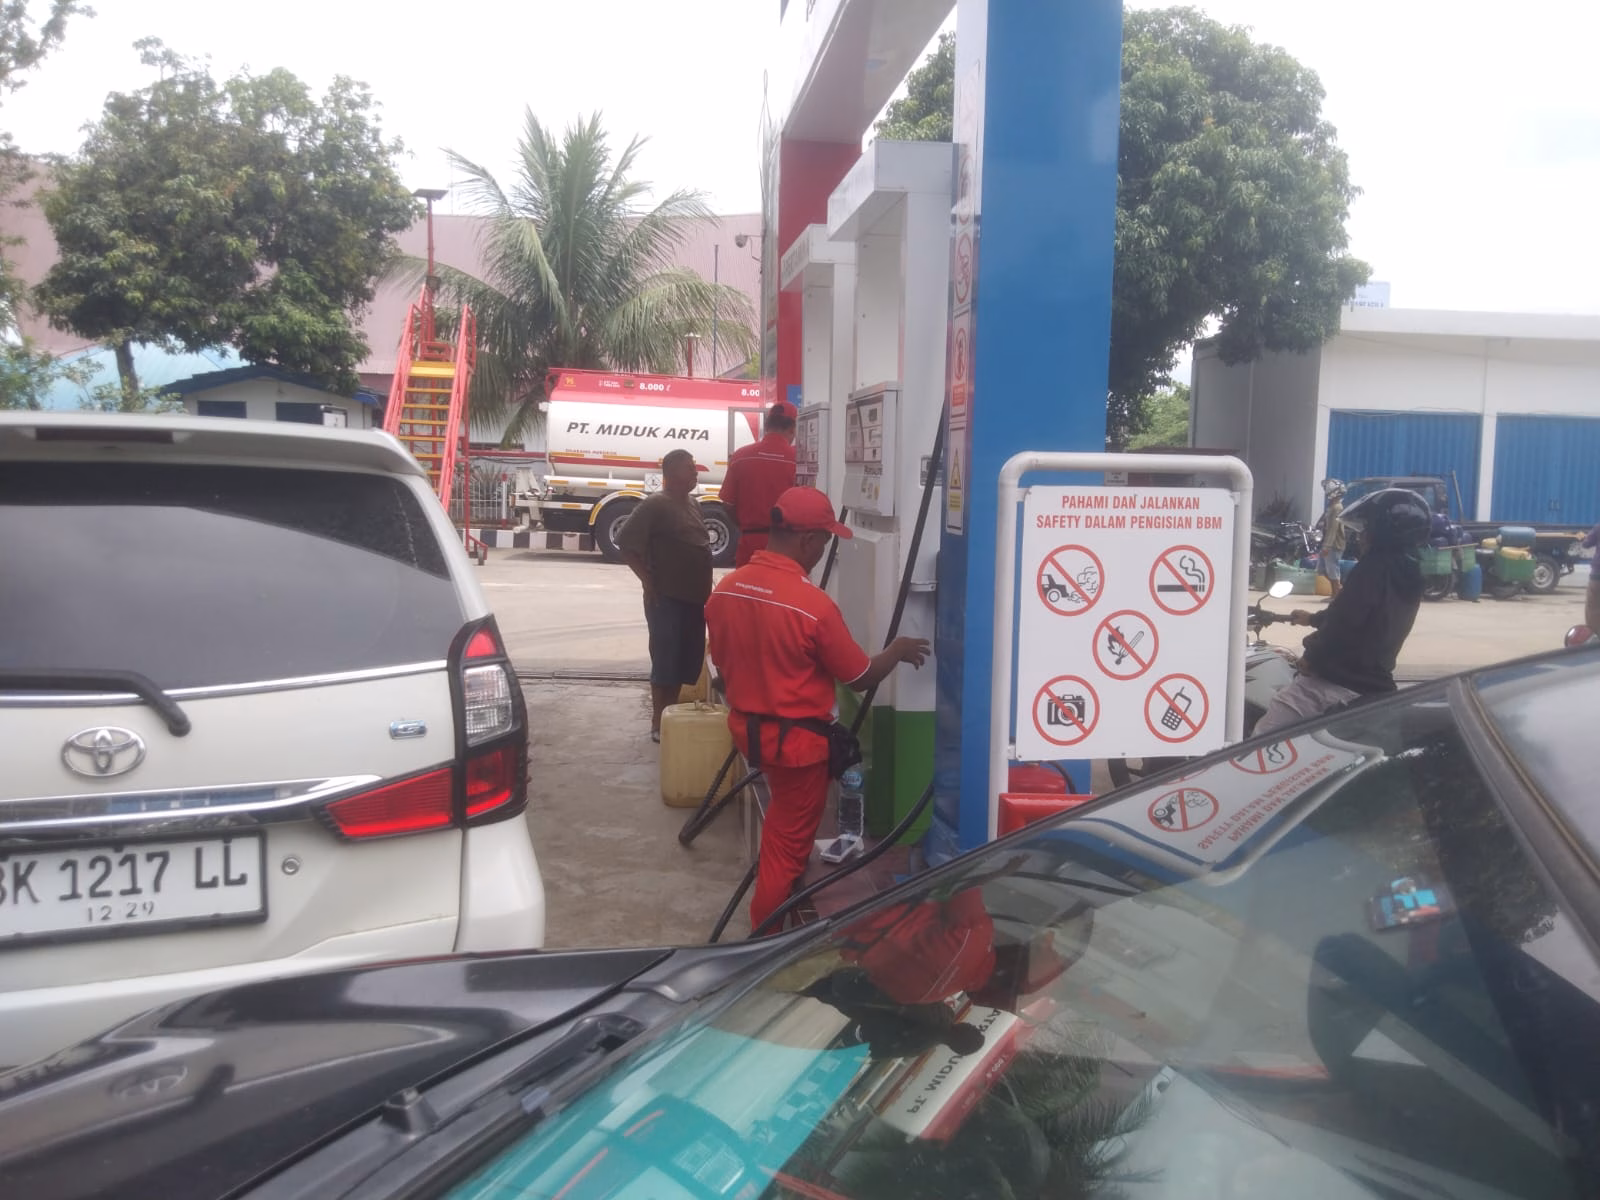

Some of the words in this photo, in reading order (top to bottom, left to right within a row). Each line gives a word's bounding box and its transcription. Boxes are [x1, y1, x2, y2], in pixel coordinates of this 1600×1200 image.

[639, 382, 665, 392] 8.000
[566, 421, 590, 435] PT.
[595, 423, 661, 439] MIDUK
[663, 427, 710, 441] ARTA
[1062, 495, 1109, 509] PAHAMI
[1112, 495, 1137, 509] DAN
[1140, 496, 1200, 510] JALANKAN
[1036, 514, 1081, 529] SAFETY
[1084, 515, 1126, 529] DALAM
[1130, 515, 1193, 529] PENGISIAN
[1196, 516, 1223, 530] BBM
[58, 850, 170, 902] 1217
[195, 845, 248, 889] LL
